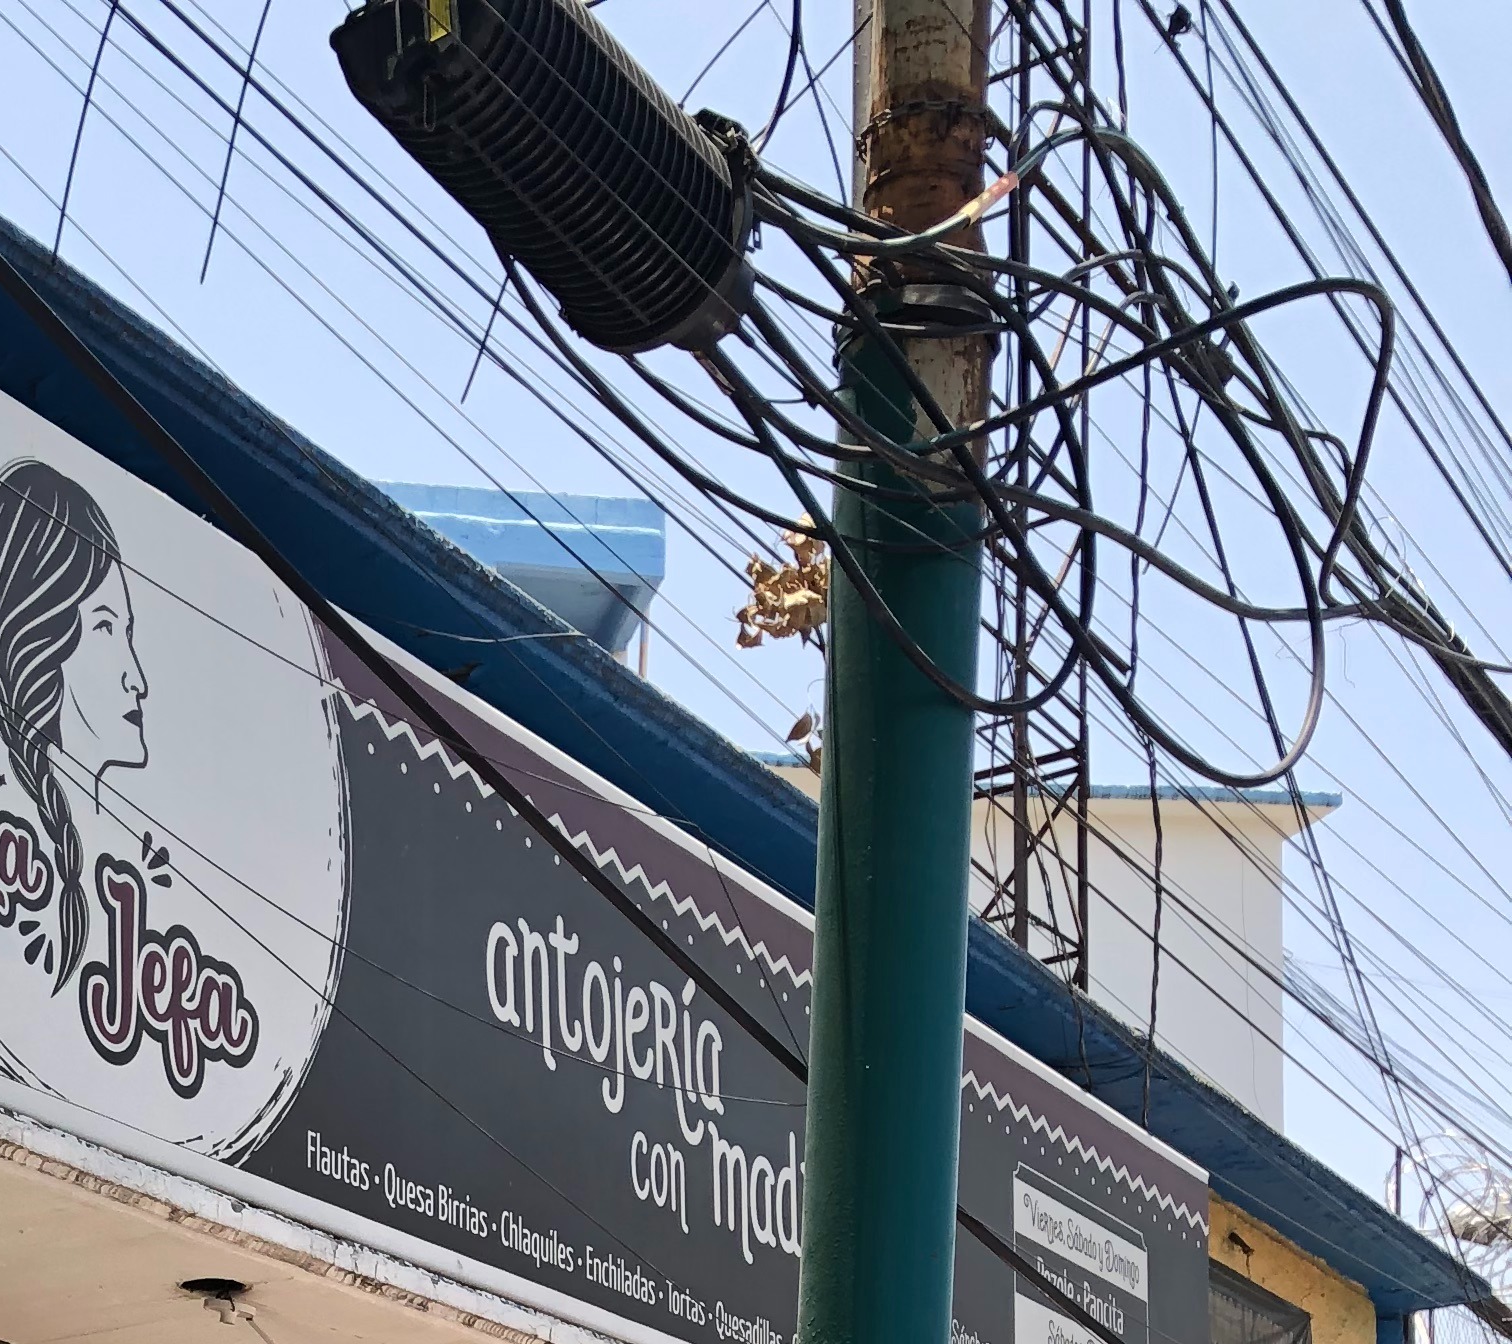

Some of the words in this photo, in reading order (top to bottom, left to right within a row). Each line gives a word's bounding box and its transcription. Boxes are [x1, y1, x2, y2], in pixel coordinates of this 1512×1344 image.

[82, 858, 256, 1094] Jefa
[306, 1129, 370, 1191] Flautas
[384, 1162, 434, 1217] Quesa
[438, 1183, 488, 1238] Birrias
[500, 1210, 575, 1273] Chlaquiles
[585, 1245, 656, 1305] Enchiladas
[665, 1279, 706, 1326] Tortas
[630, 1130, 689, 1235] con
[707, 1120, 806, 1265] mad
[1098, 1242, 1104, 1273] y
[1104, 1239, 1140, 1290] Domingo
[1083, 1280, 1125, 1335] Pancita
